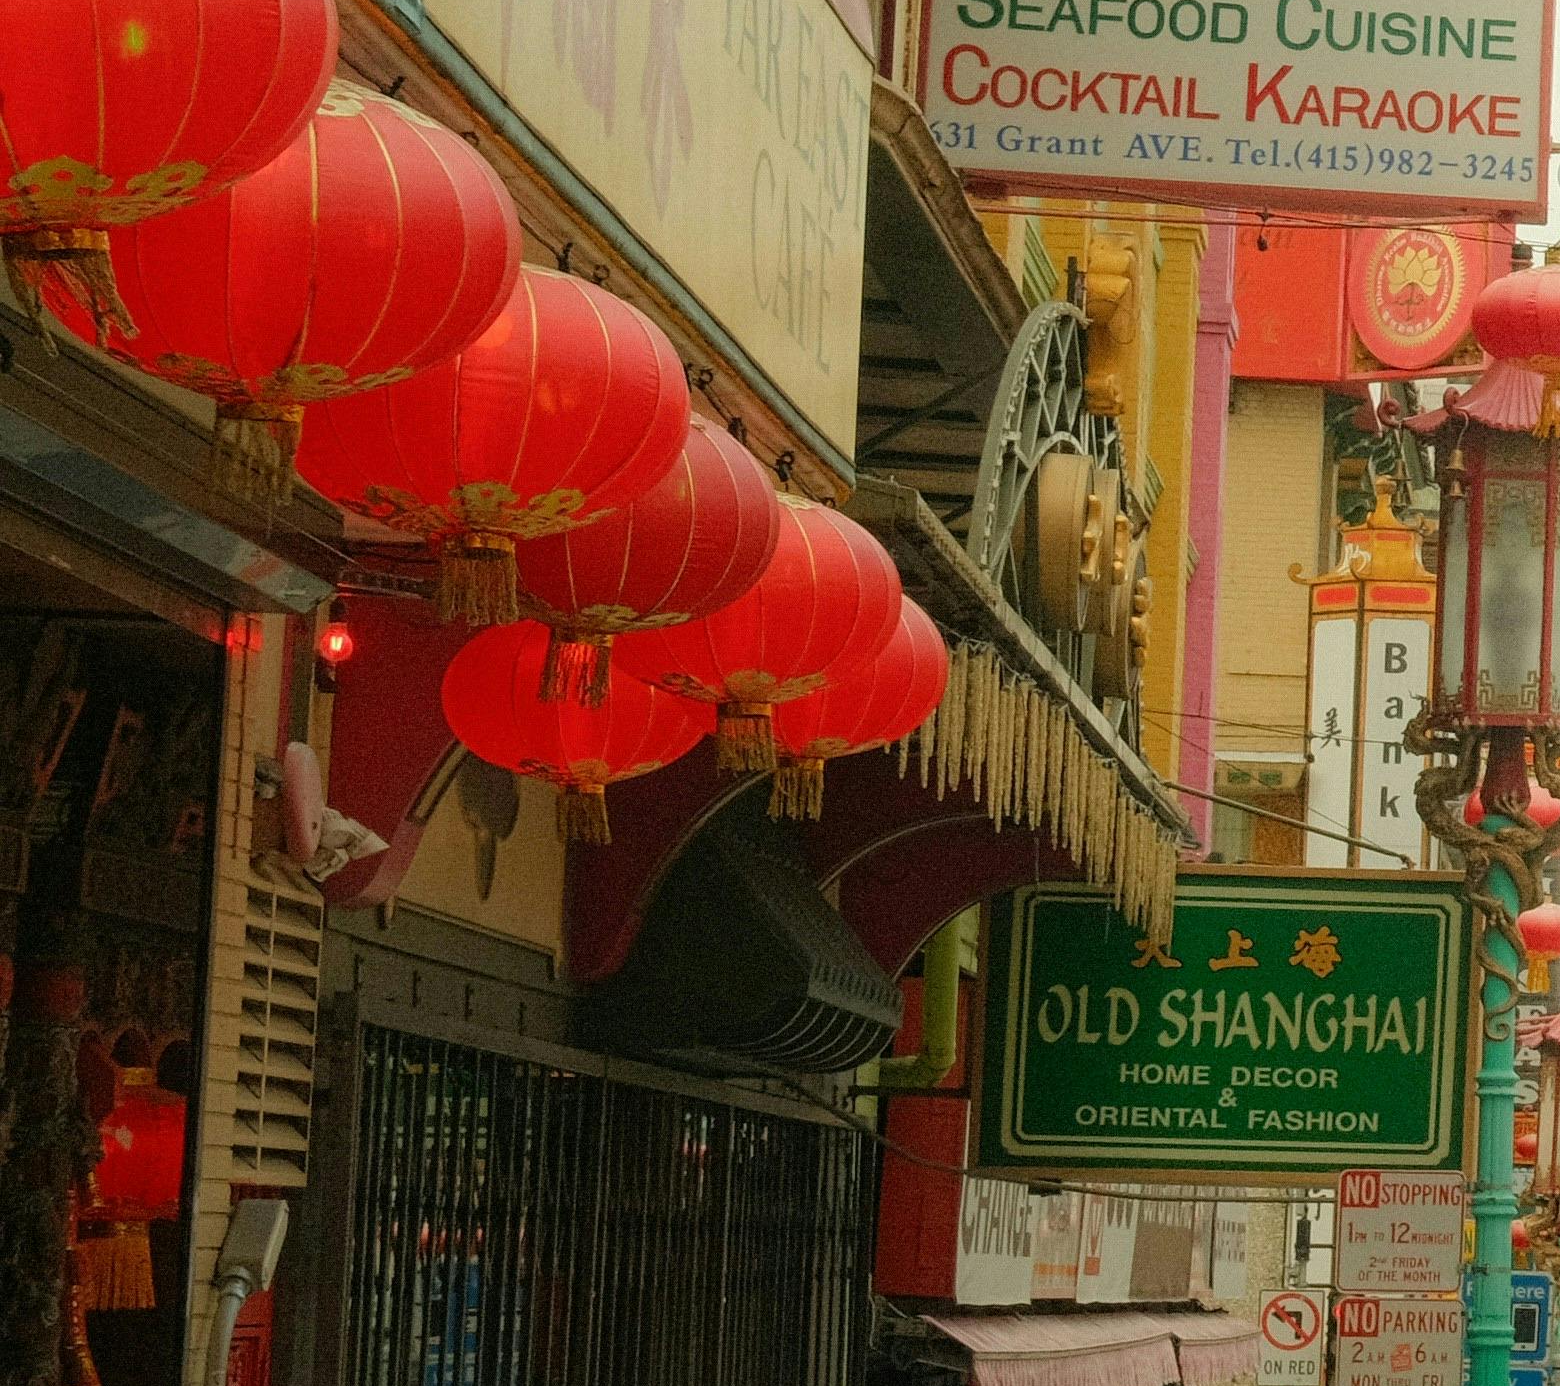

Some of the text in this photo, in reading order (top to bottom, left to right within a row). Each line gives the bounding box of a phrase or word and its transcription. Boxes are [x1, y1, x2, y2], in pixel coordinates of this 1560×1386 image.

[942, 44, 1522, 138] COCKTAIL KARAOKE
[996, 126, 1104, 158] Grant
[1124, 134, 1215, 164] AVE.
[1037, 983, 1429, 1054] OLD SHANGHAI
[1120, 1063, 1339, 1089] HOME DECOR
[1218, 1087, 1238, 1108] &
[1075, 1104, 1380, 1132] ORIENTAL FASHION
[1345, 1174, 1462, 1208] NO STOPPING
[1377, 1270, 1398, 1282] THE
[1402, 1270, 1441, 1284] MONTH
[1345, 1302, 1458, 1335] NO PARKING
[1264, 1360, 1315, 1376] ON RED
